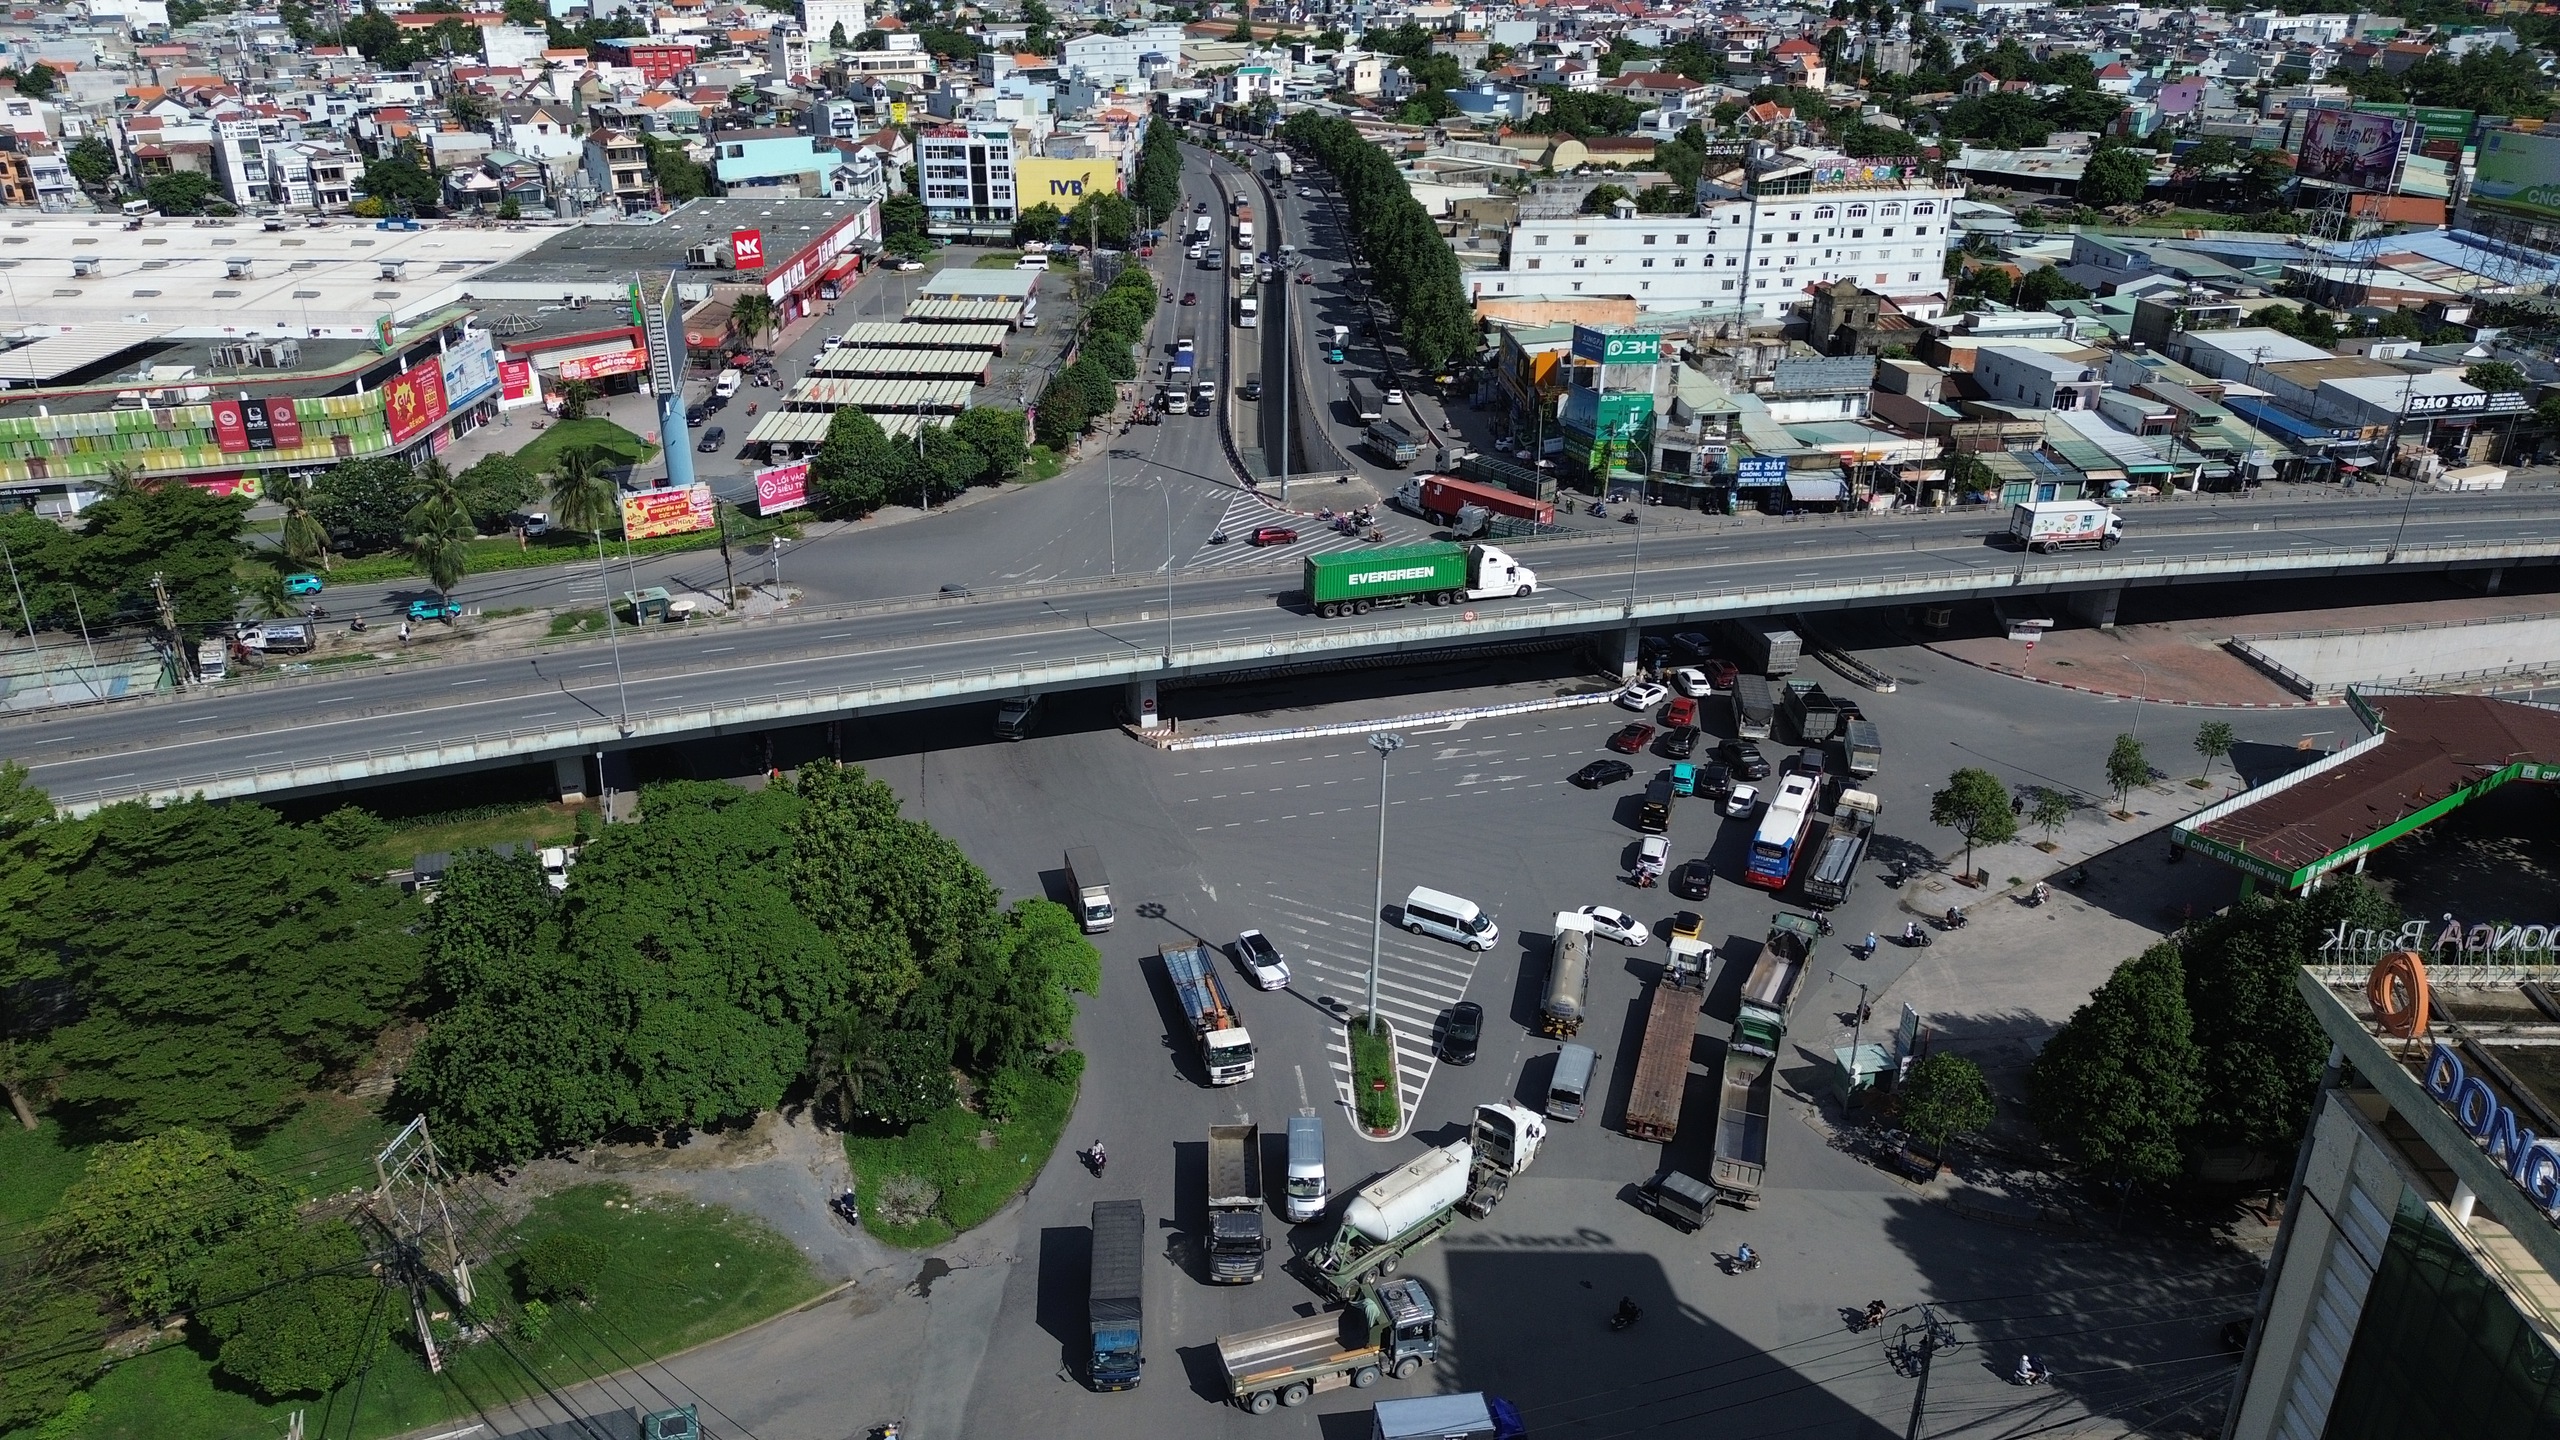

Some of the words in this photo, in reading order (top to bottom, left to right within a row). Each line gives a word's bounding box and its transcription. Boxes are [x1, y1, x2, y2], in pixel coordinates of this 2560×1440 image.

[1817, 165, 1917, 181] KARAOKE
[736, 238, 759, 255] NK
[1764, 458, 1785, 470] SẮT
[777, 475, 789, 485] LỐI
[1349, 566, 1434, 585] EVERGREEN
[1756, 855, 1780, 864] HYUNDAI
[2190, 840, 2215, 856] CHẤT
[2217, 850, 2235, 864] ĐỐT
[2267, 870, 2286, 884] NAI
